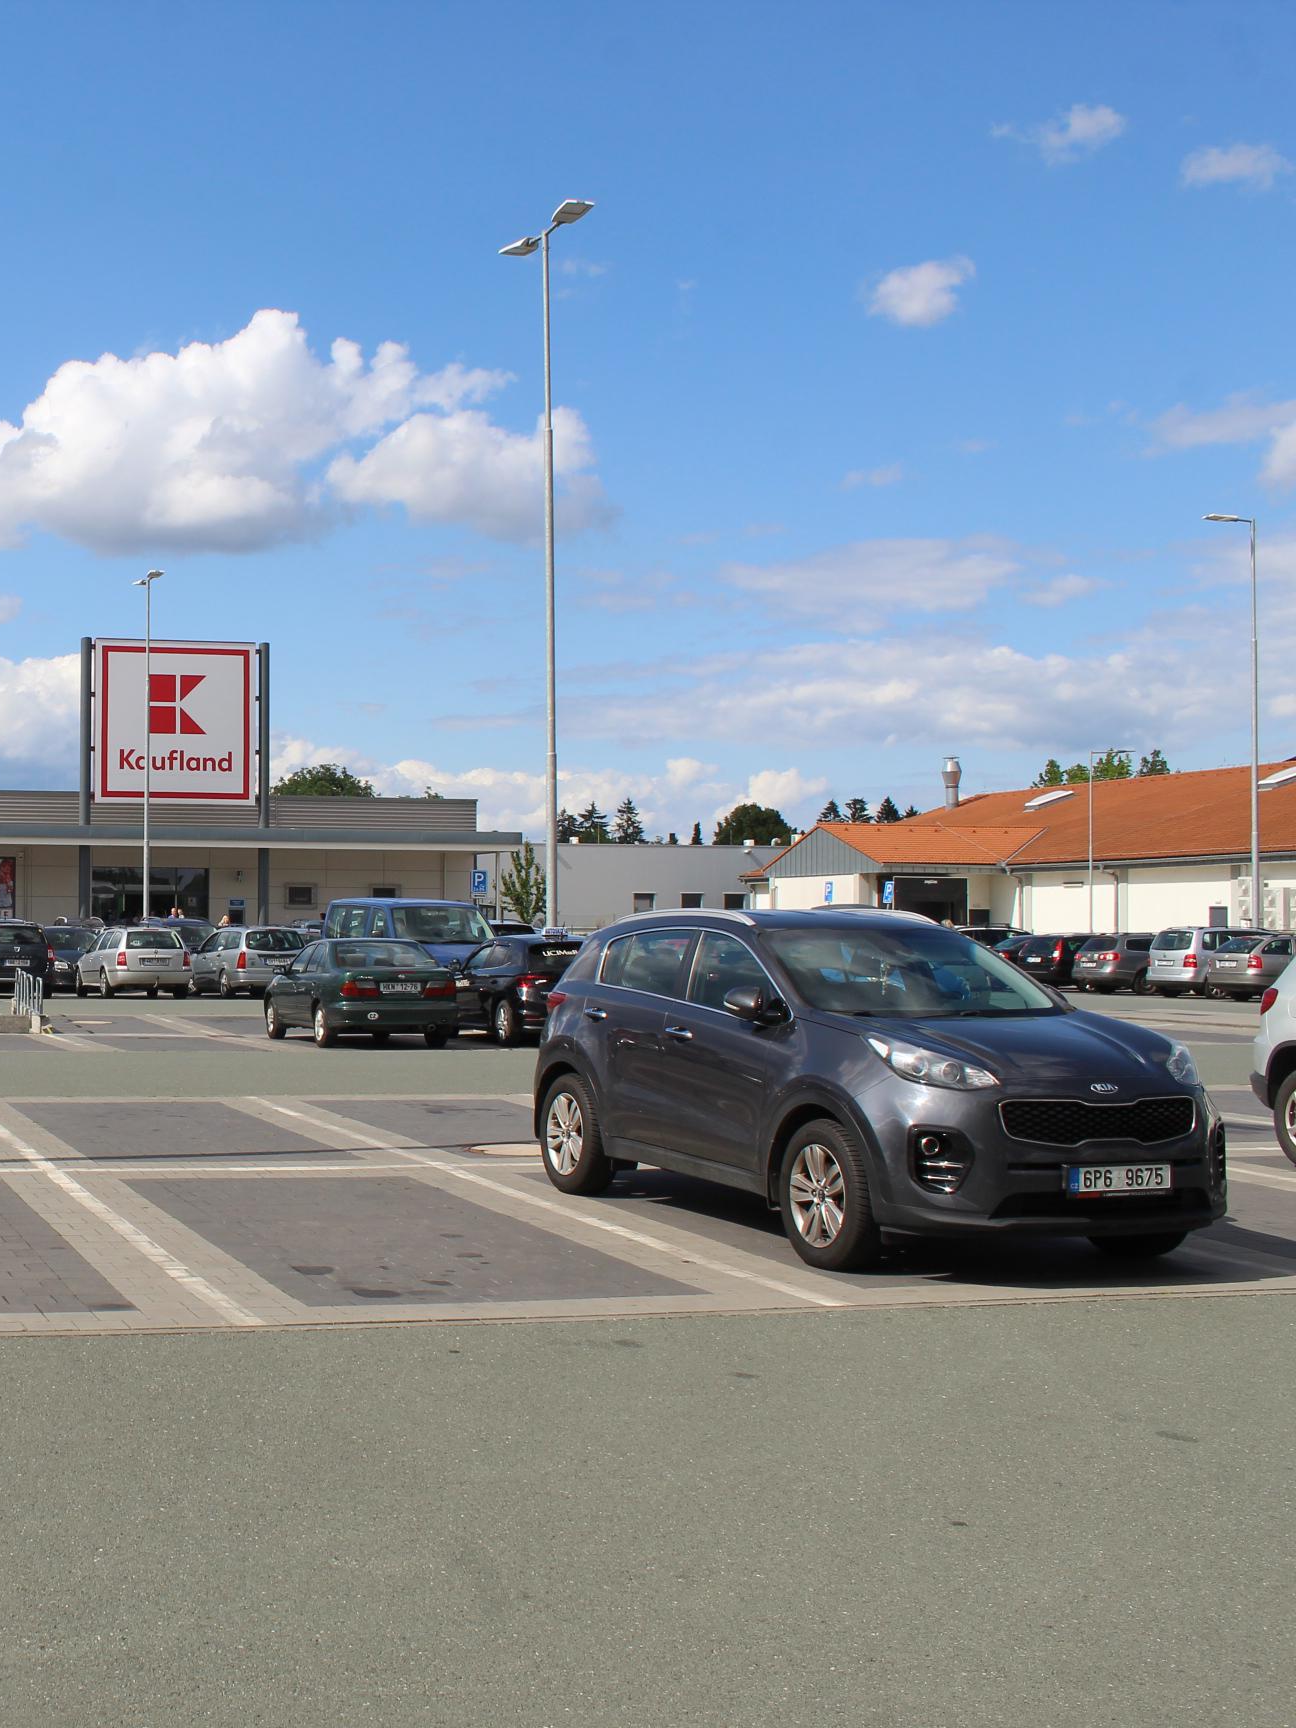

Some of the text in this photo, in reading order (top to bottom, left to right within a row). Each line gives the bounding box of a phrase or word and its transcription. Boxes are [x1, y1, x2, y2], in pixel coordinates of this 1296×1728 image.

[119, 749, 233, 772] Kaufland
[474, 872, 484, 886] P
[825, 884, 832, 895] P
[1083, 1167, 1163, 1188] 6P6 9675
